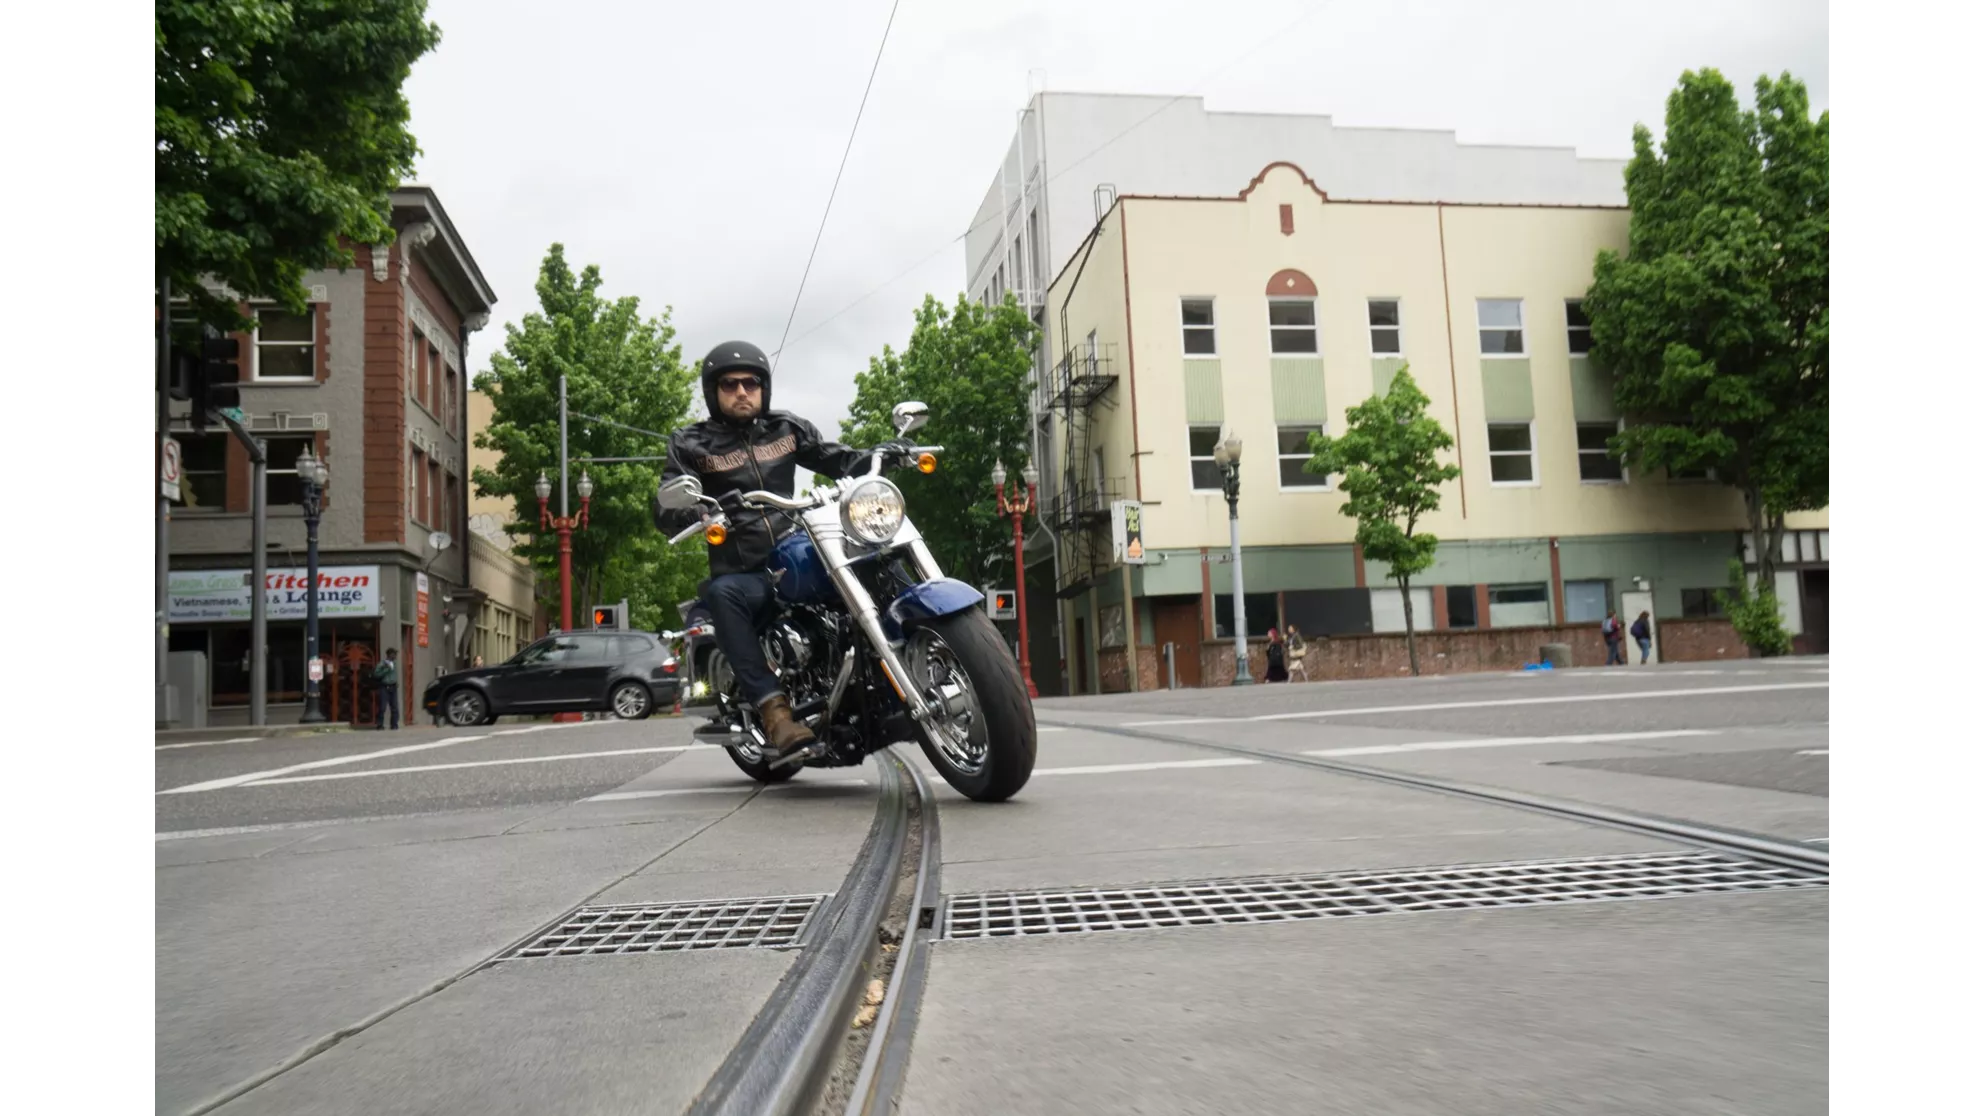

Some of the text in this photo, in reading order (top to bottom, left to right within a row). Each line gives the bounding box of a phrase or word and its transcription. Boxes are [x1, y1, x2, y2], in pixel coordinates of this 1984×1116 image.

[264, 573, 369, 590] Kitchen
[173, 597, 242, 607] Vietnamese,
[272, 595, 280, 604] &
[286, 590, 362, 605] Lounge
